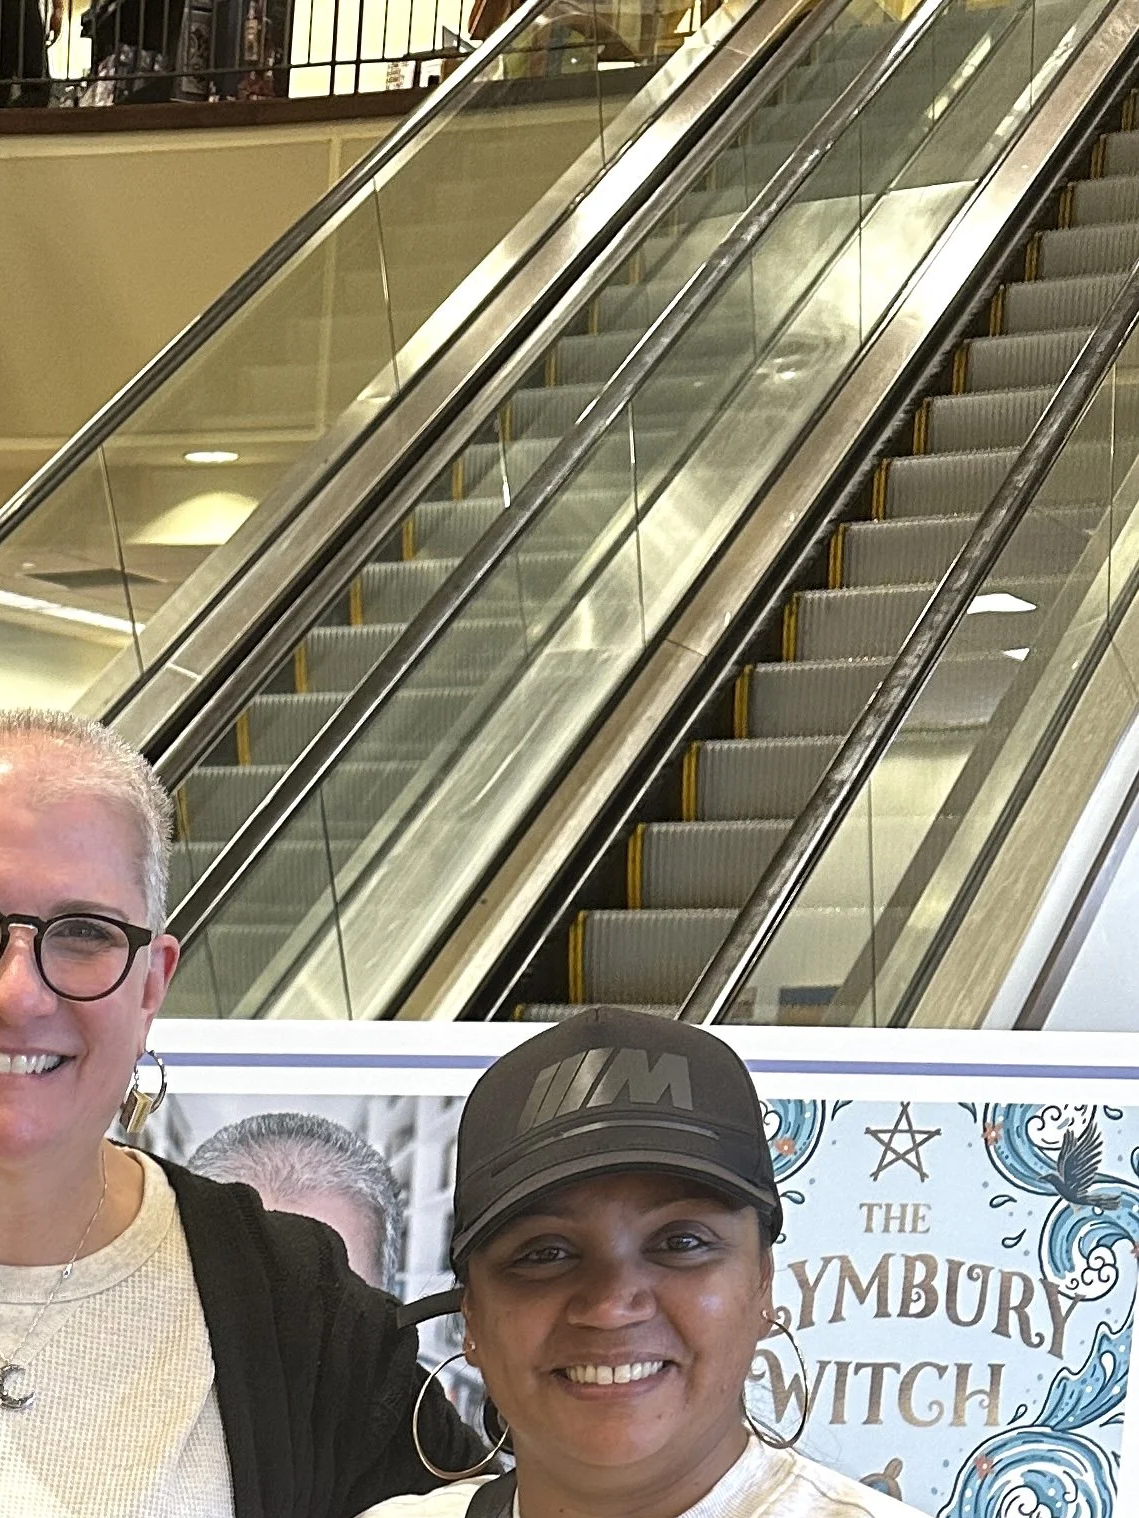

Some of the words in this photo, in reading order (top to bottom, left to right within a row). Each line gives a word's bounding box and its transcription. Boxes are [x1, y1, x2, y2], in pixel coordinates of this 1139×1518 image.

[859, 1202, 932, 1235] THE
[759, 1252, 1087, 1360] YMBURY
[748, 1347, 1007, 1429] WITCH
